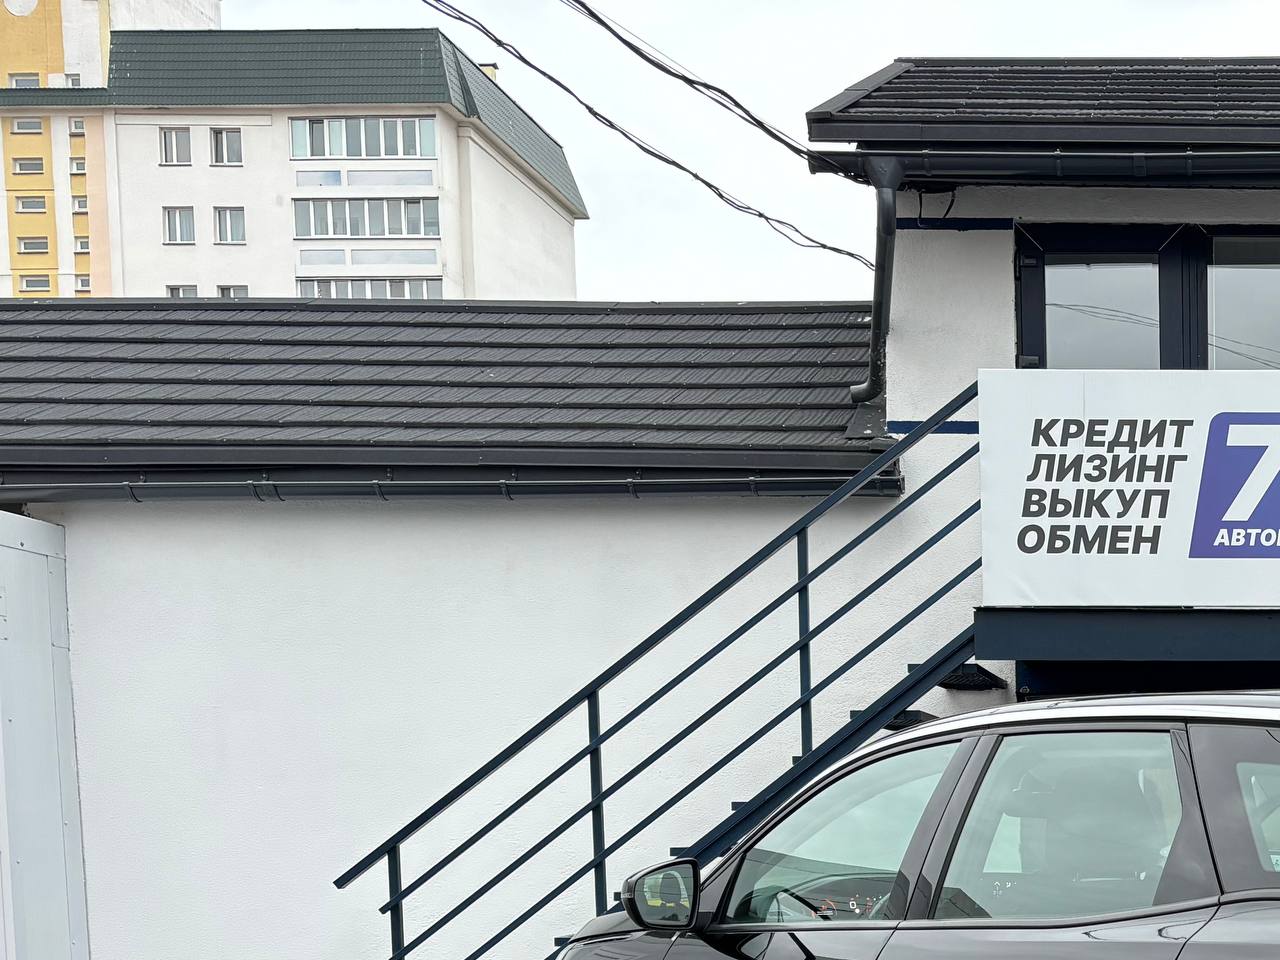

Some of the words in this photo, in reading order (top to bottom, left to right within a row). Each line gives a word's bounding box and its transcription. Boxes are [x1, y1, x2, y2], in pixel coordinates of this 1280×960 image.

[1031, 418, 1194, 453] КРЕДИТ
[1026, 453, 1188, 483] ЛИЗИНГ
[1021, 488, 1170, 518] ВЫКУП
[1017, 524, 1162, 555] ОБМЕН
